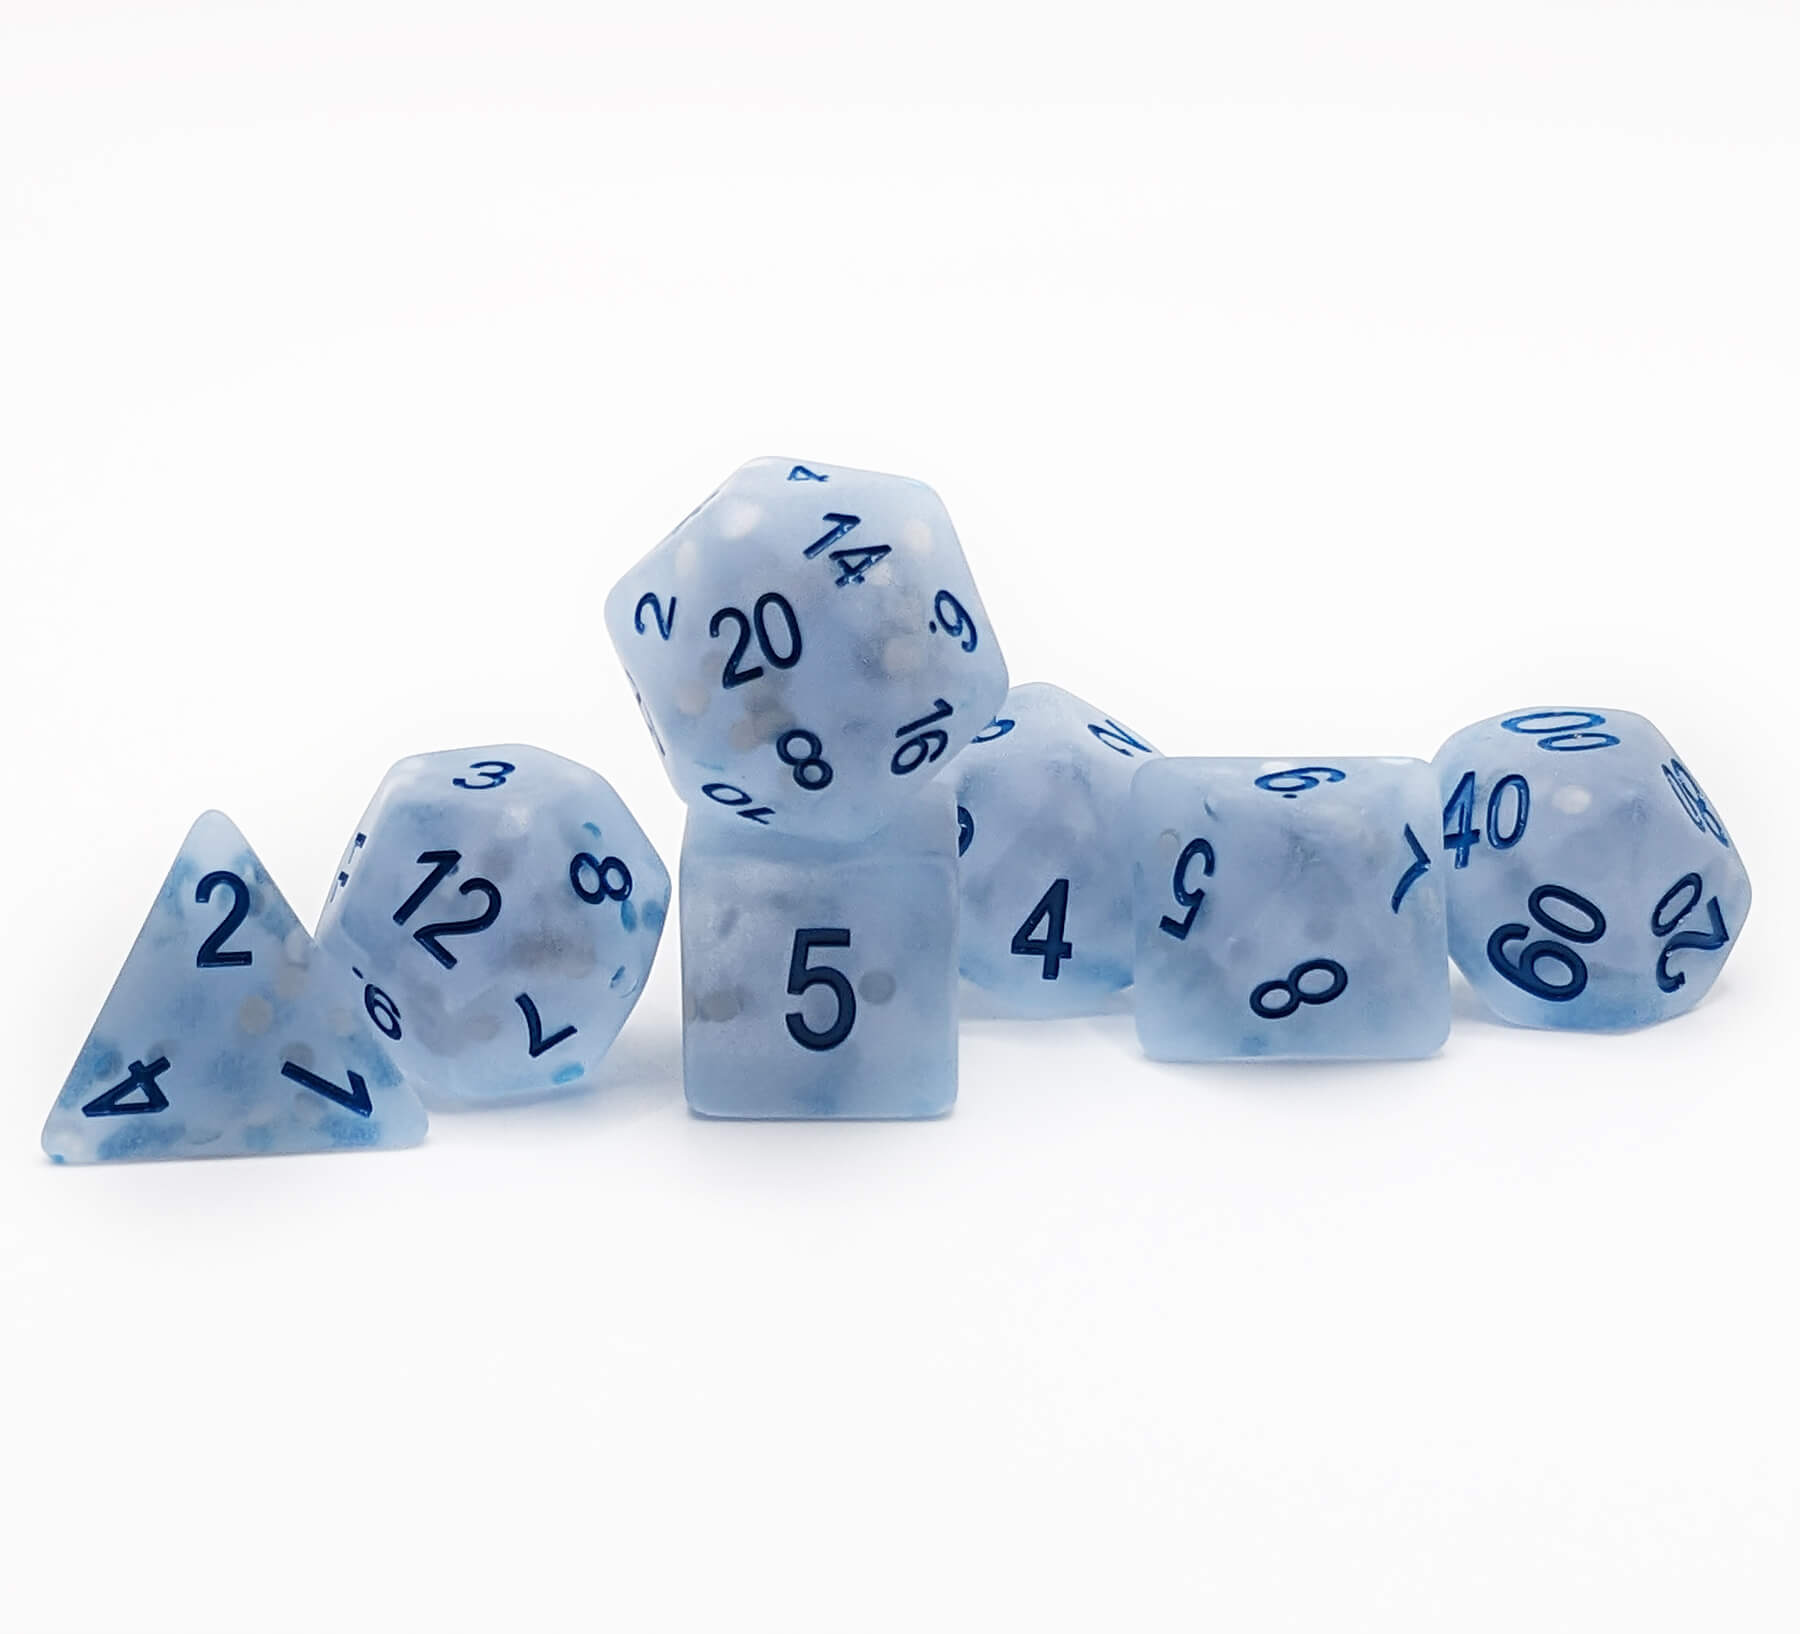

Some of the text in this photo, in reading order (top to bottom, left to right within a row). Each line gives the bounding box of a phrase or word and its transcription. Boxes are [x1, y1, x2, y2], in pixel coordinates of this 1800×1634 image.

[787, 465, 829, 483] 4
[803, 512, 893, 588] 14
[634, 592, 677, 641] 2
[709, 591, 803, 690] 20
[775, 728, 834, 792] 8
[890, 697, 955, 776] 16
[1088, 719, 1153, 757] 2
[1501, 711, 1621, 752] 00
[453, 761, 516, 790] 3
[701, 782, 775, 825] 10
[1442, 770, 1531, 870] 40
[569, 851, 633, 905] 8
[1159, 837, 1216, 941] 5
[1391, 823, 1433, 915] 7
[194, 870, 262, 969] 2
[392, 849, 503, 971] 12
[1010, 878, 1073, 981] 4
[1486, 883, 1607, 1003] 60
[1650, 872, 1731, 994] 20
[785, 926, 857, 1053] 5
[1248, 957, 1349, 1020] 8
[515, 993, 578, 1059] 7
[81, 1056, 172, 1118] 4
[280, 1060, 374, 1119] 1
